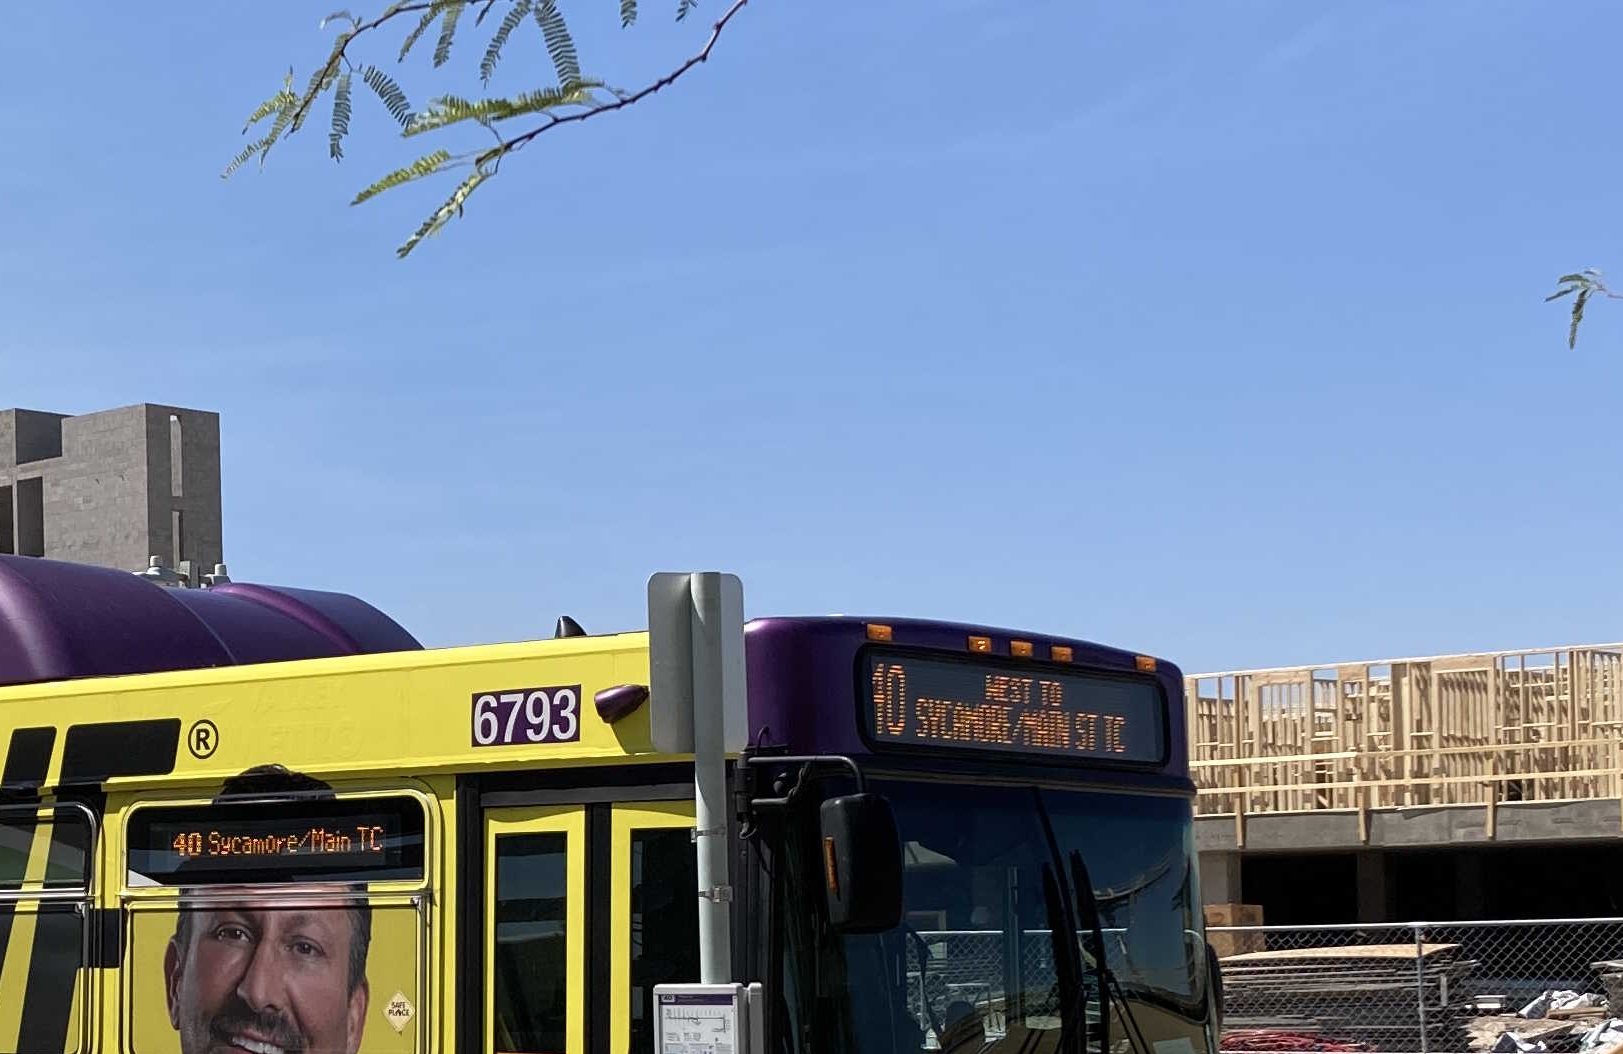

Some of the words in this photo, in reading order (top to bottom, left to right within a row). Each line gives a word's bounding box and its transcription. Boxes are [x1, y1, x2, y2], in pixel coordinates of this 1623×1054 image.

[1039, 680, 1064, 706] TO
[474, 688, 577, 745] 6793
[1075, 712, 1098, 751] ST
[1103, 715, 1126, 752] TC
[173, 832, 203, 857] 40
[208, 828, 352, 856] Sycamore/Main
[356, 825, 384, 851] TC
